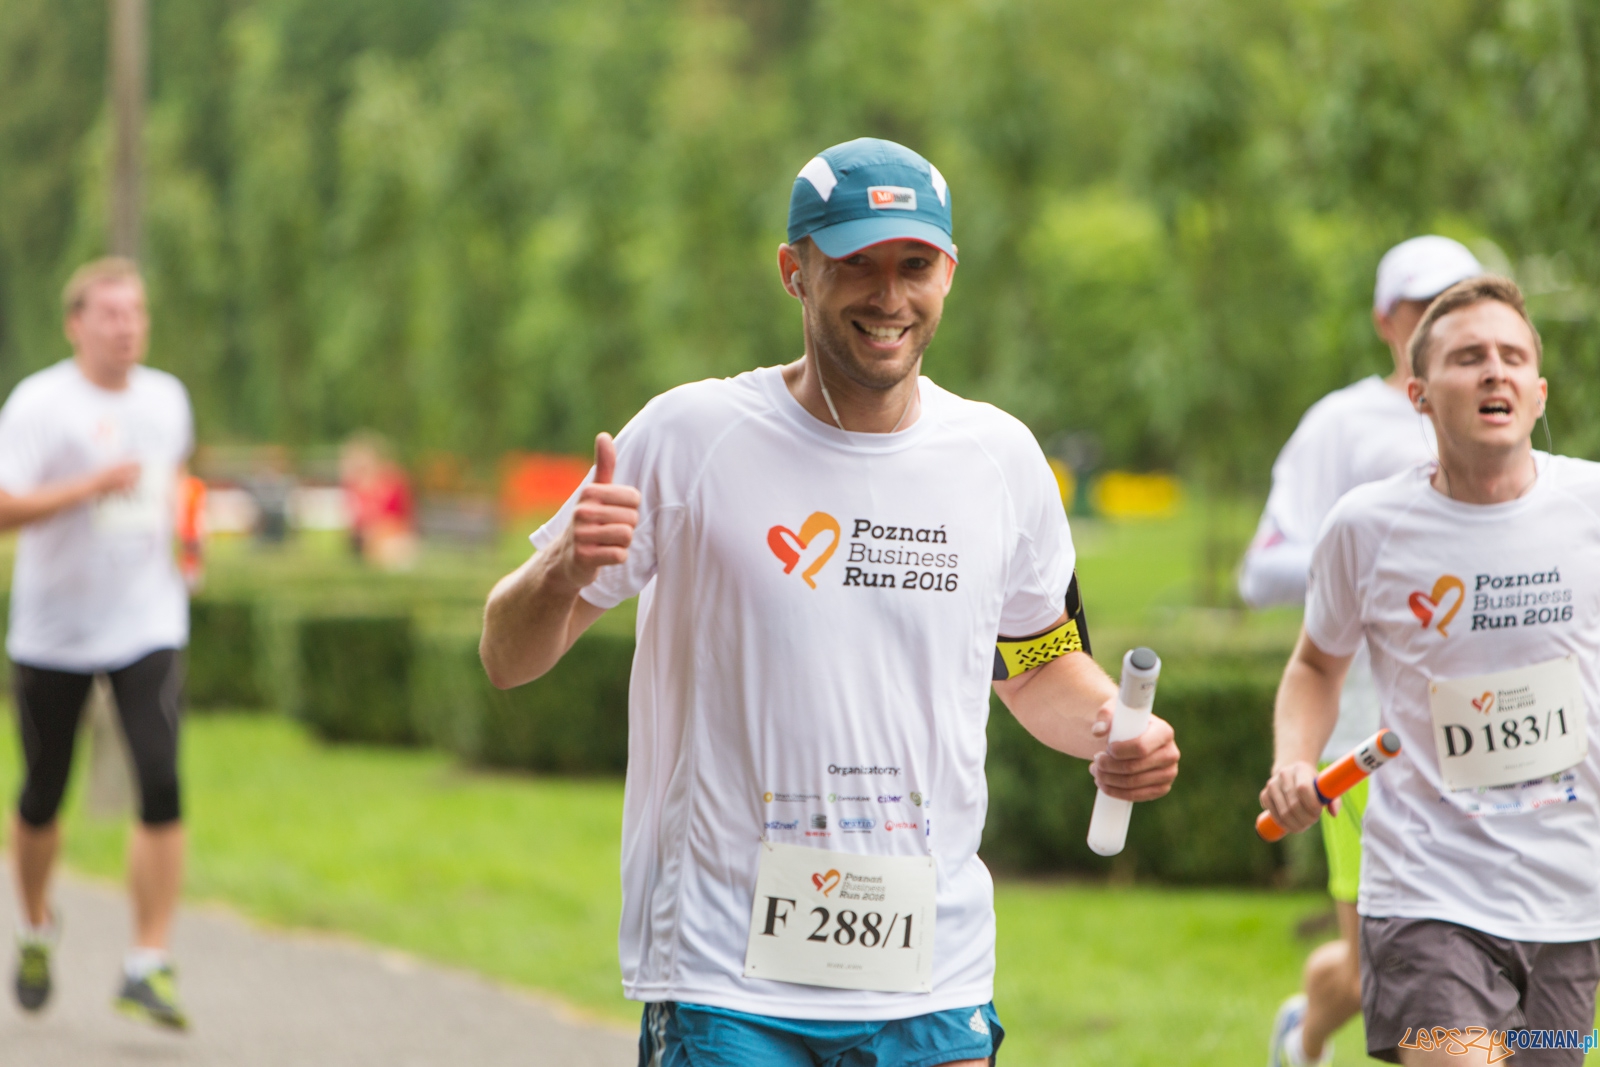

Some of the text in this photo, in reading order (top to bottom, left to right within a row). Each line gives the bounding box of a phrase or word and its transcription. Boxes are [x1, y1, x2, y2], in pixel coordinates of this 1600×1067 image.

[852, 520, 946, 543] Poznań
[848, 543, 958, 568] Business
[843, 567, 958, 592] Run 2016
[1475, 568, 1560, 591] Poznań
[1473, 588, 1572, 612] Business
[1471, 606, 1573, 631] Run 2016
[1443, 724, 1474, 759] D
[1482, 708, 1569, 753] 183/1
[759, 895, 796, 936] F
[806, 907, 914, 949] 288/1
